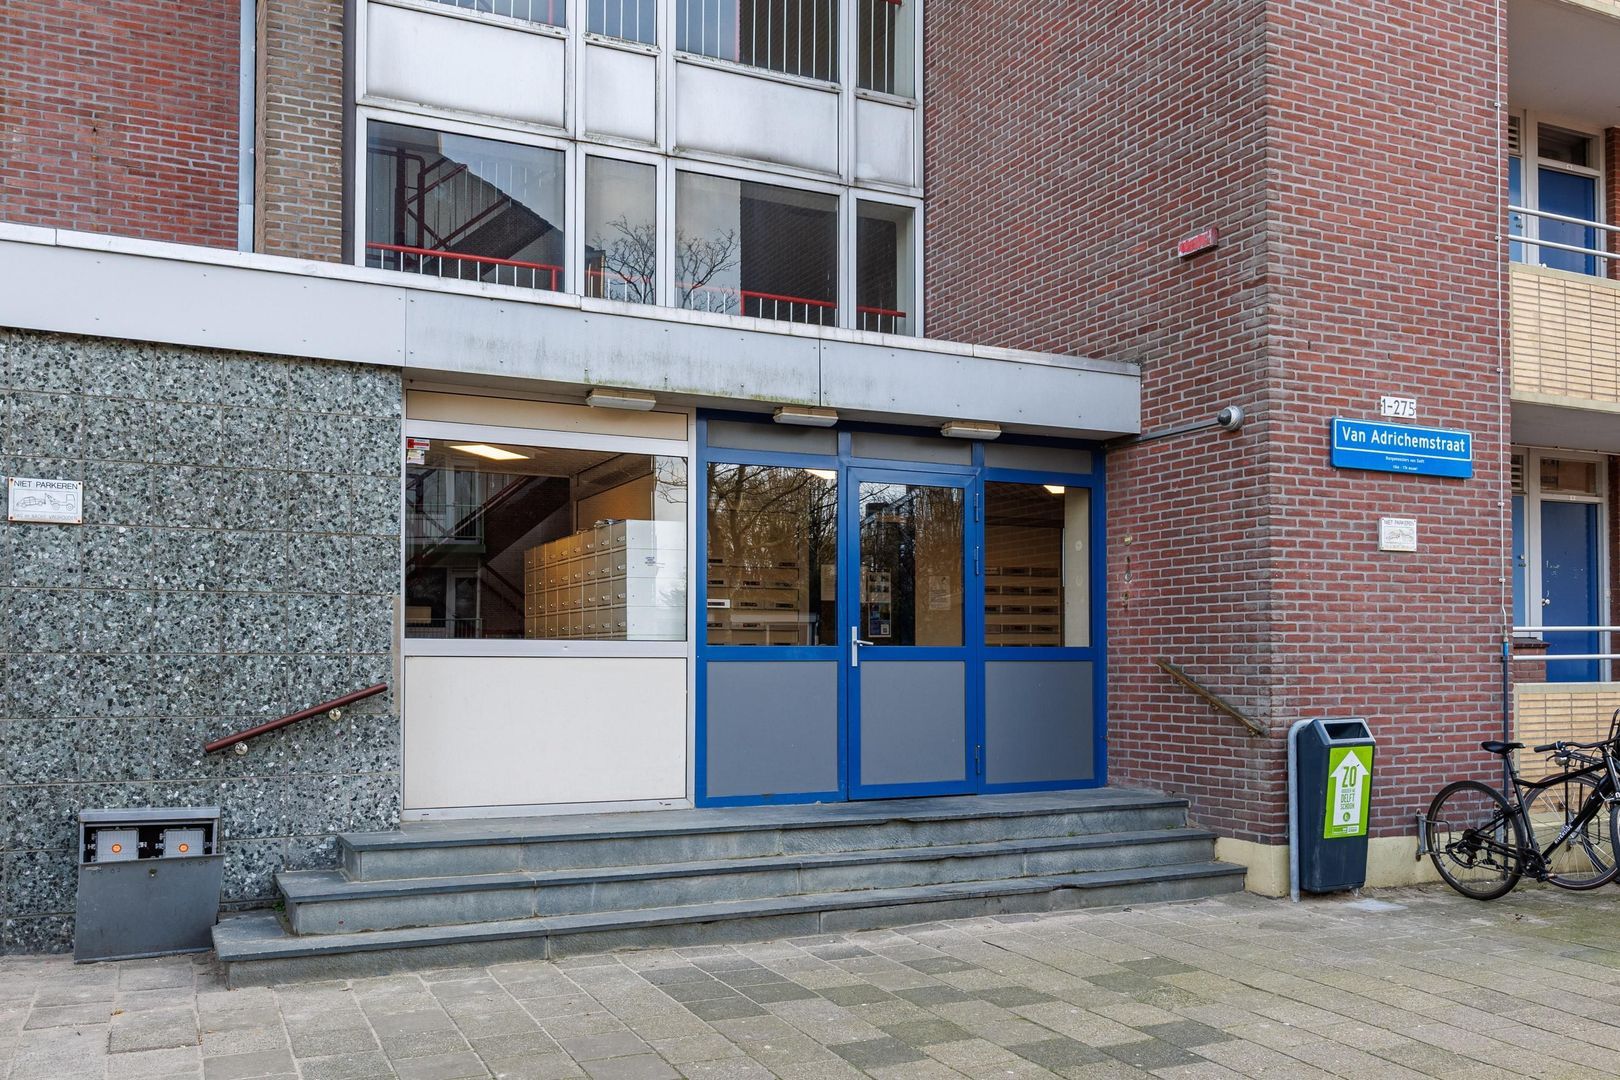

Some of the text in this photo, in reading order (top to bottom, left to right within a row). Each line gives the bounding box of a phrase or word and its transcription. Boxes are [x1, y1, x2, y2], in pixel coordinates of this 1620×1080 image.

[1382, 398, 1415, 416] 1-275
[1342, 426, 1465, 452] Van Adrichemstraat
[14, 480, 78, 490] NIET PARKEREN
[1341, 793, 1355, 803] DELFT
